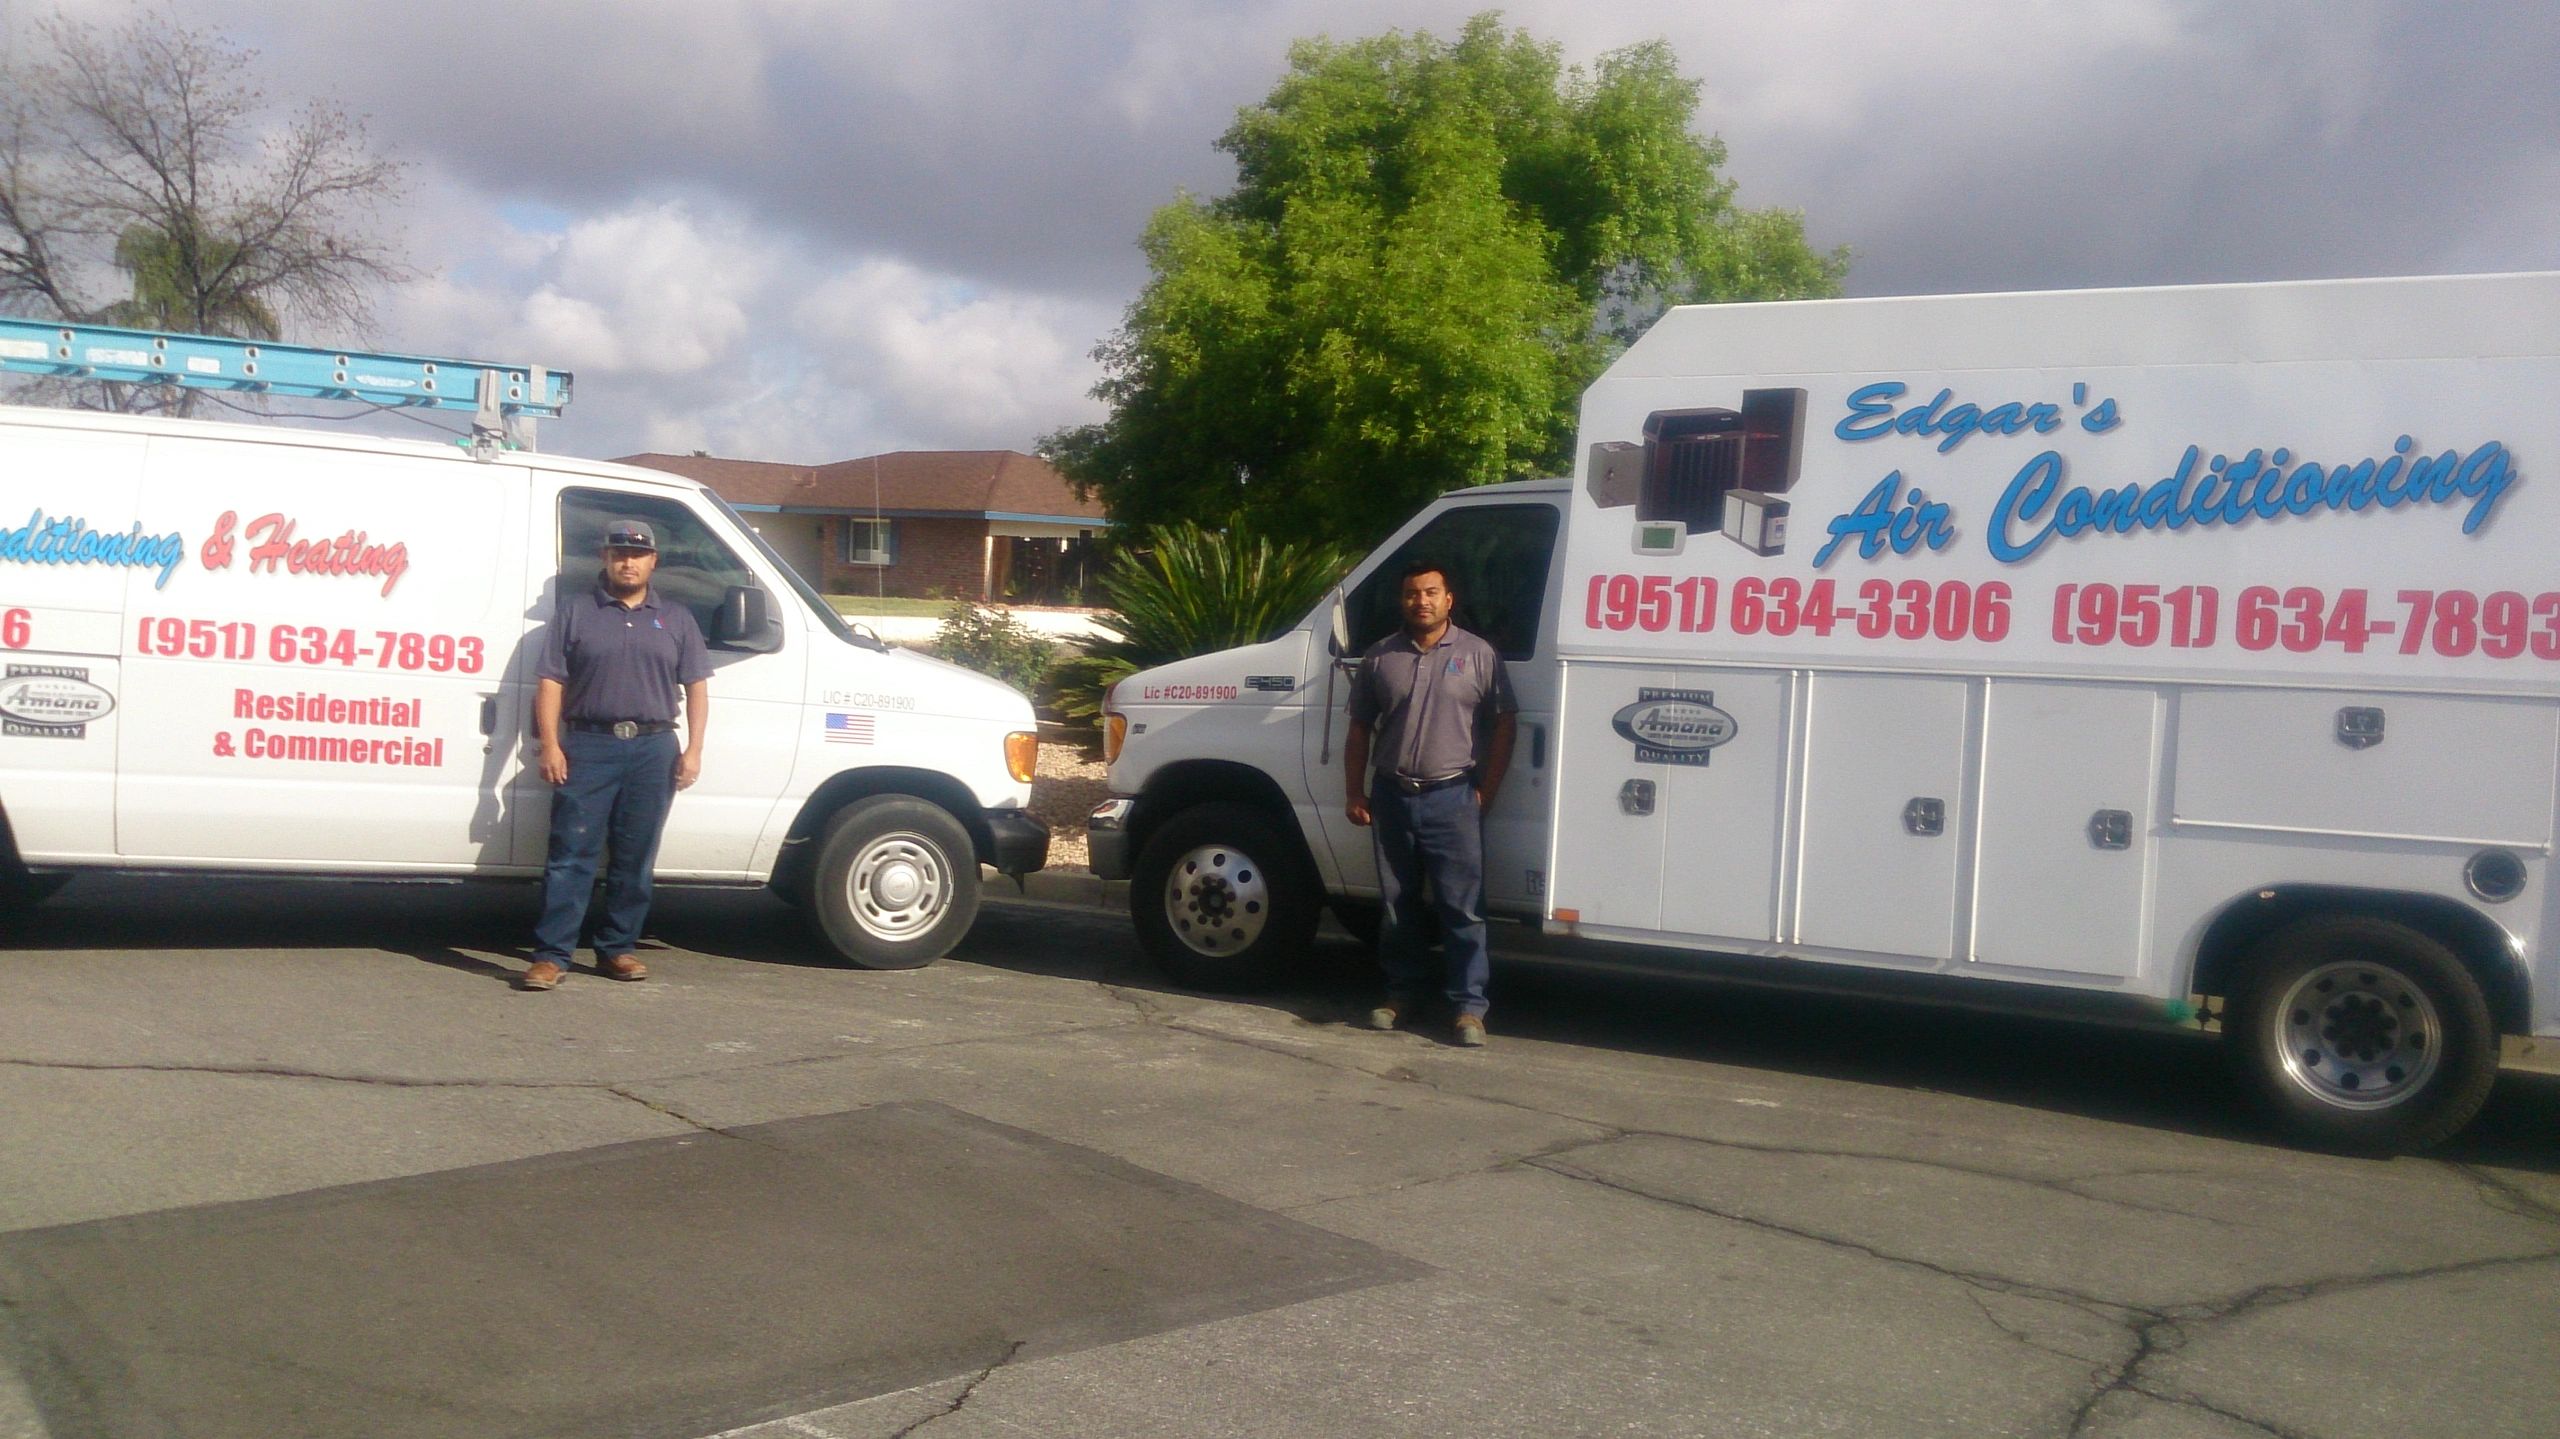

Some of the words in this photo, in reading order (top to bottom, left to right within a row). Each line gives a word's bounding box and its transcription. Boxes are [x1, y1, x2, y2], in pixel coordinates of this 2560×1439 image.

[1834, 381, 2116, 453] Edgar's
[1812, 469, 1953, 568] Air
[1986, 433, 2517, 564] Conditioning
[201, 510, 237, 571] &
[245, 512, 409, 598] Heating
[1585, 573, 1719, 634] (951)
[1730, 576, 2012, 642] 634-3306
[2051, 583, 2219, 648] (951)
[2235, 585, 2560, 660] 634-7893
[138, 617, 256, 660] (951)
[269, 624, 485, 674] 634-7893
[6, 684, 99, 710] Amana
[233, 688, 421, 728] Residential
[823, 690, 841, 704] LIC
[1144, 685, 1160, 699] Lic
[1164, 686, 1237, 699] #C20-891900
[1643, 690, 1711, 704] PREMIUM
[1638, 707, 1723, 736] Amana
[213, 731, 236, 757] &
[245, 727, 444, 767] Commercial
[1640, 749, 1704, 763] QUALITY
